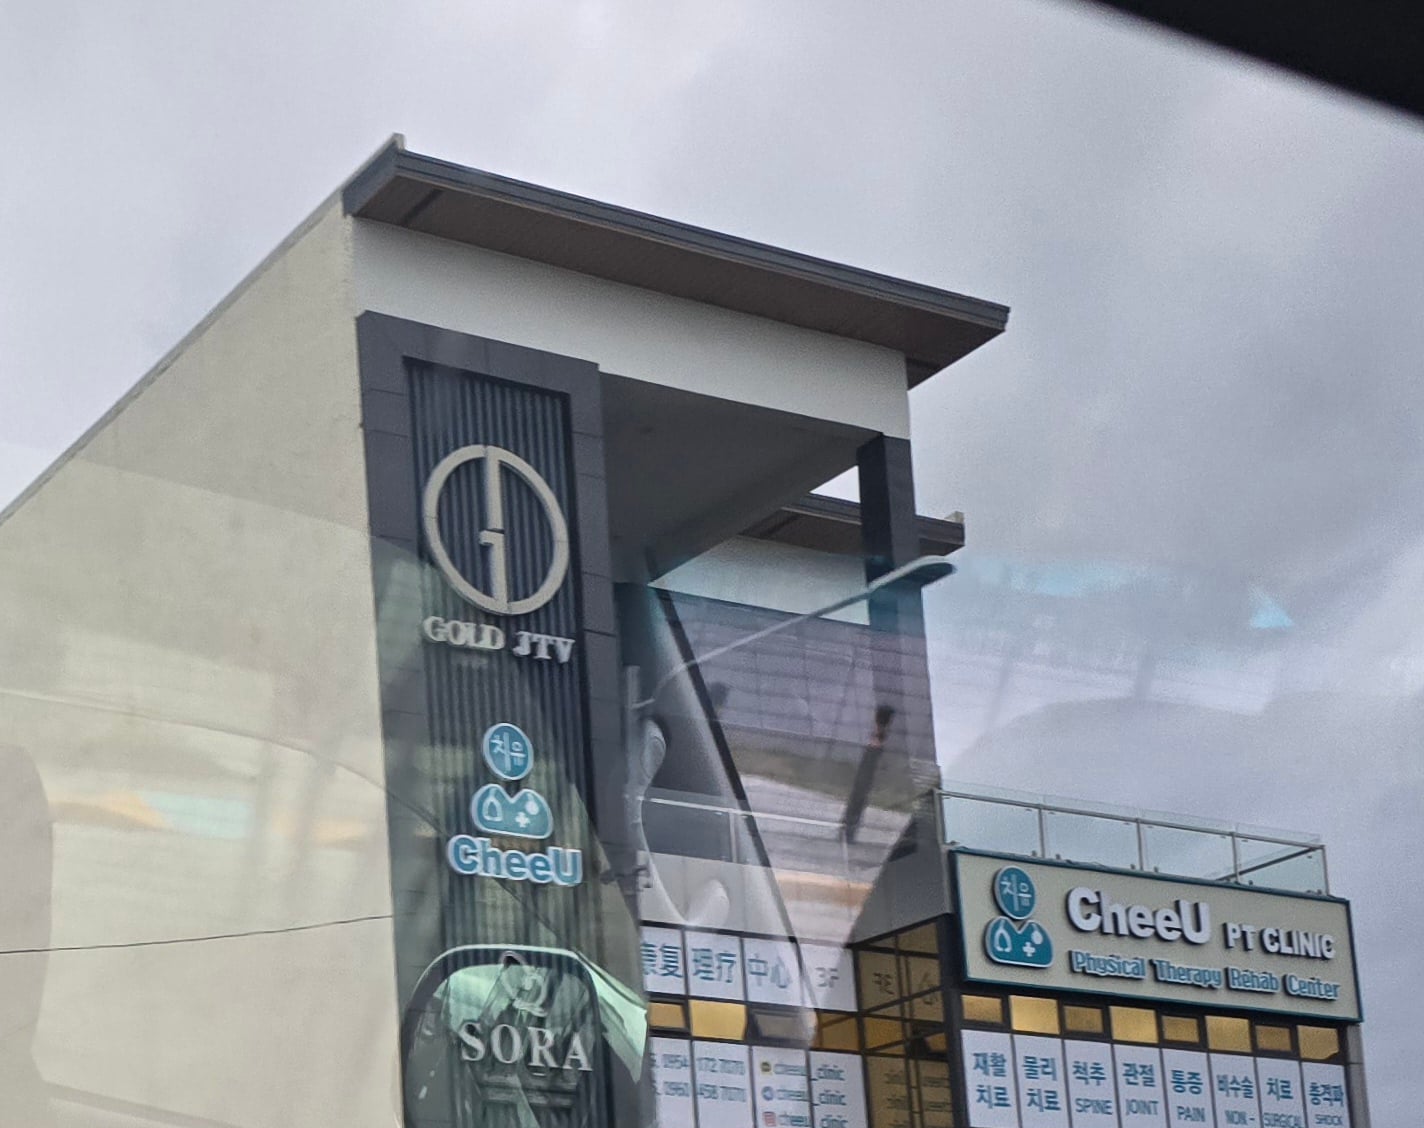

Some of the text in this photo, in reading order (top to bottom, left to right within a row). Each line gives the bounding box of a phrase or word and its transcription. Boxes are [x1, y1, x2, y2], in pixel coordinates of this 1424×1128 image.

[424, 616, 576, 664] GOLD JTV
[447, 834, 583, 887] CheeU
[1066, 886, 1336, 960] CheeU PT CLINIC
[1071, 950, 1340, 1000] Physical Therapy Rehab Center
[458, 1021, 594, 1072] SORA
[972, 1052, 1007, 1078] 재활
[1023, 1055, 1057, 1081] 물리
[1073, 1061, 1106, 1086] 척추
[1122, 1062, 1156, 1087] 관절
[1170, 1069, 1203, 1094] 통증
[1266, 1077, 1294, 1101] 치료
[976, 1084, 1012, 1109] 치료
[1026, 1088, 1061, 1113] 치료
[1076, 1098, 1113, 1115] SPINE
[1125, 1098, 1159, 1116] JOINT
[1177, 1105, 1206, 1122] PAIN
